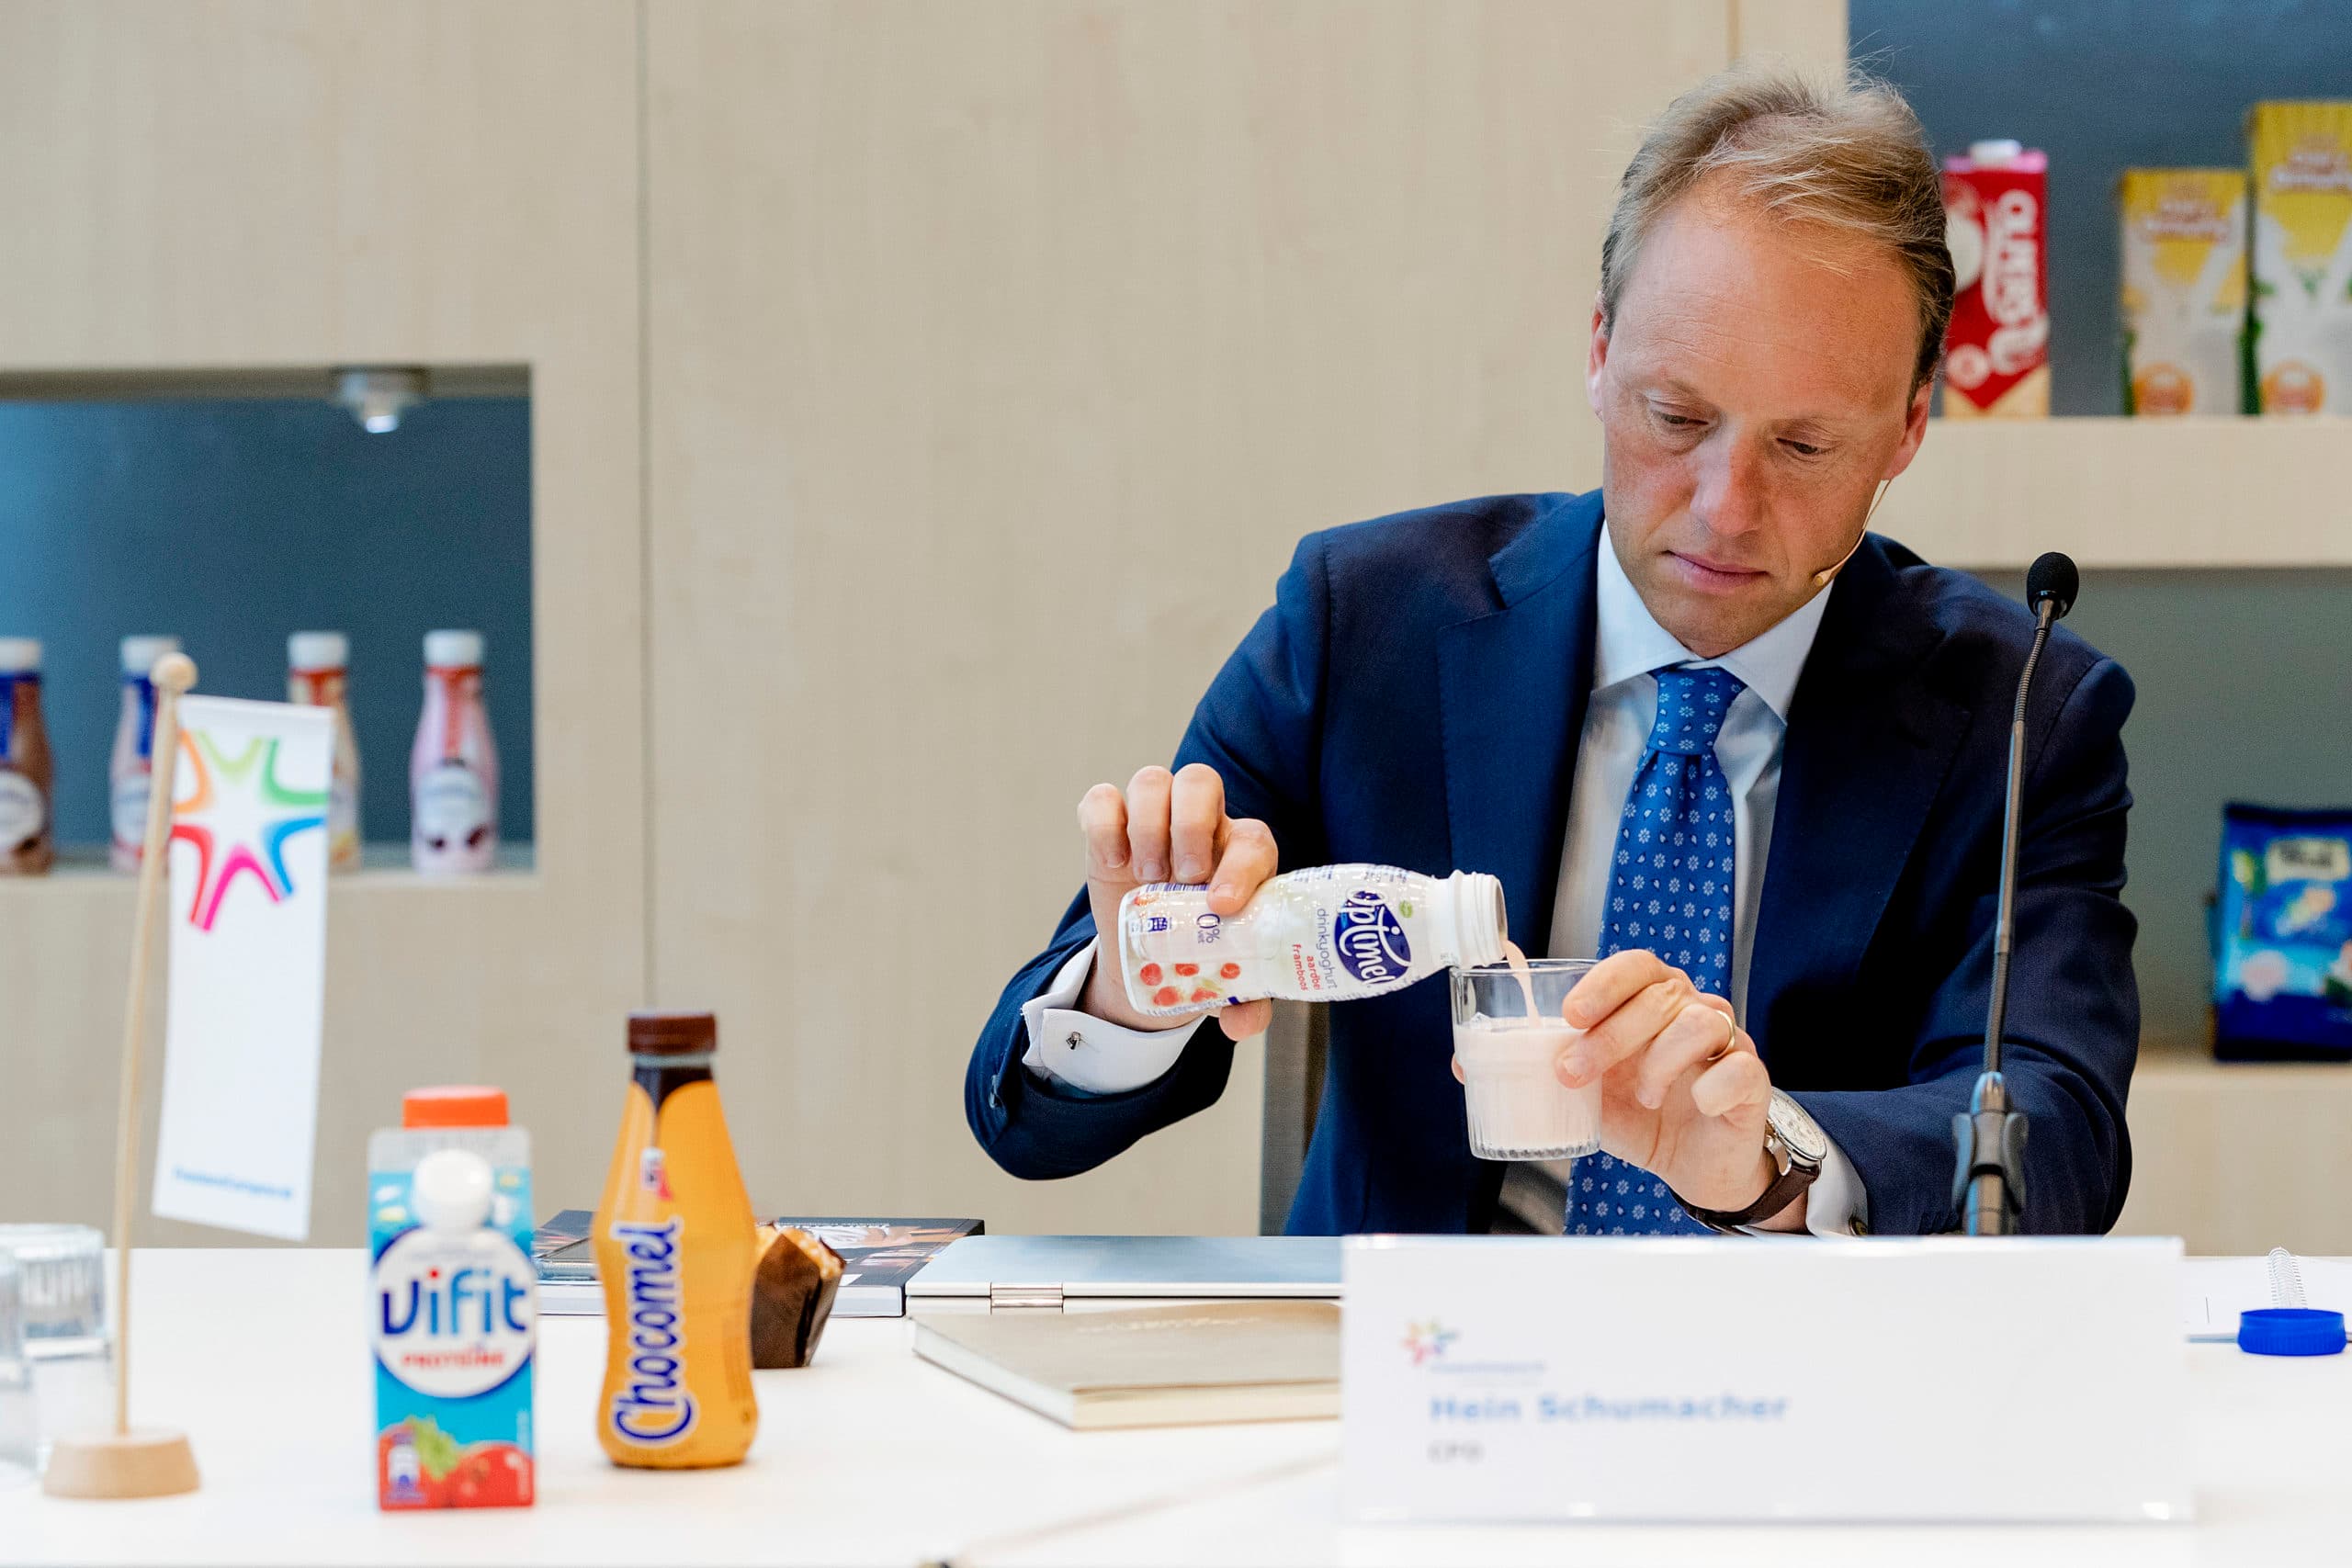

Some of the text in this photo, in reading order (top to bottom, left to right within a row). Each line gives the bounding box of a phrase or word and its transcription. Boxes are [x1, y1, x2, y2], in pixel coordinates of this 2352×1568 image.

[1306, 955, 1323, 990] aardbei
[1316, 908, 1338, 989] drinkyoghurt
[1337, 887, 1411, 985] Optimel
[612, 1220, 694, 1441] Chocomel
[1430, 1393, 1789, 1421] Hein Schumacher
